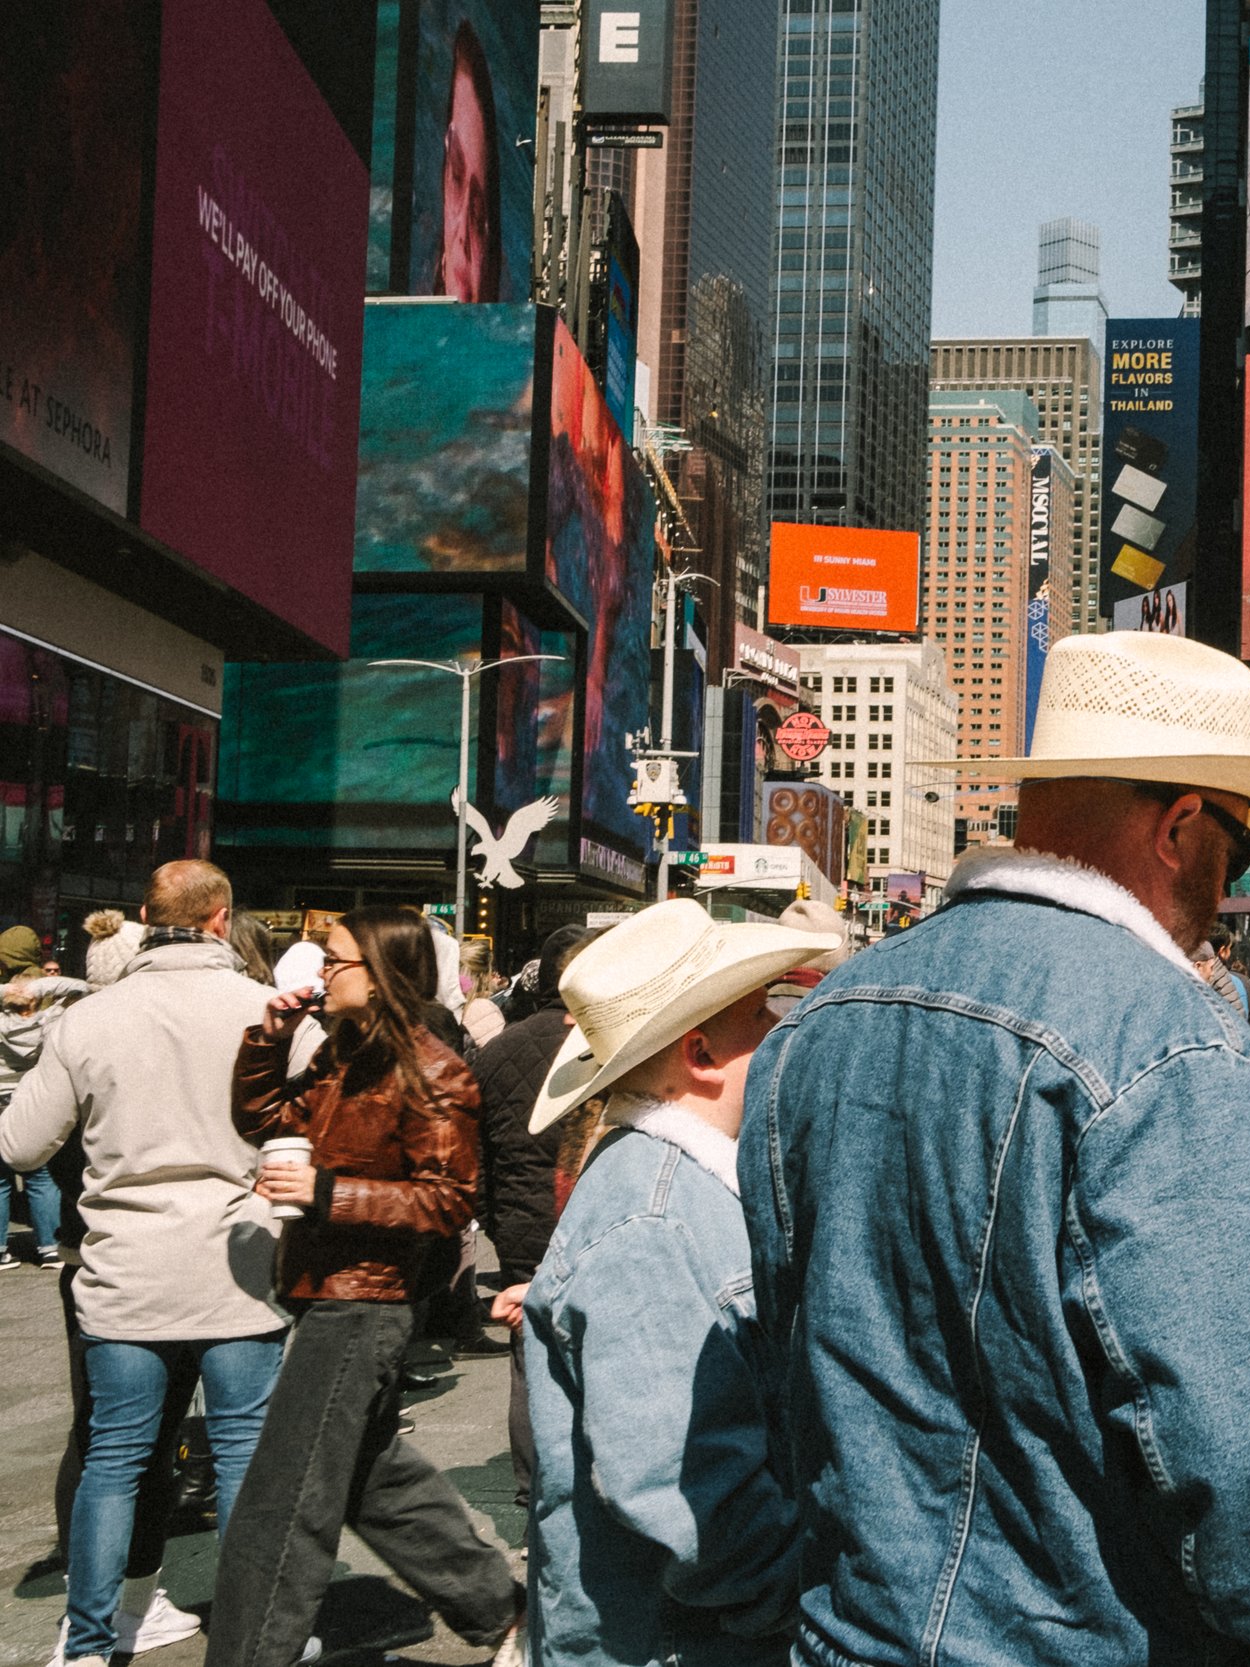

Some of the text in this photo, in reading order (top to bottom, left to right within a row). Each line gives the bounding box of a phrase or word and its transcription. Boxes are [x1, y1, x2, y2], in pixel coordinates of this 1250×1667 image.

[199, 184, 337, 381] WE'LL PAY OFF YOUR PHONE
[1112, 339, 1174, 350] EXPLORE
[1112, 352, 1173, 370] MORE
[1112, 372, 1173, 385] FLAVORS
[1134, 388, 1149, 398] IN
[1110, 400, 1174, 412] THAILAND
[20, 379, 42, 417] AT
[46, 396, 112, 469] SEPHORA
[828, 588, 887, 603] SYLVESTER
[678, 852, 687, 863] W
[688, 853, 700, 864] 46
[439, 904, 449, 914] 46
